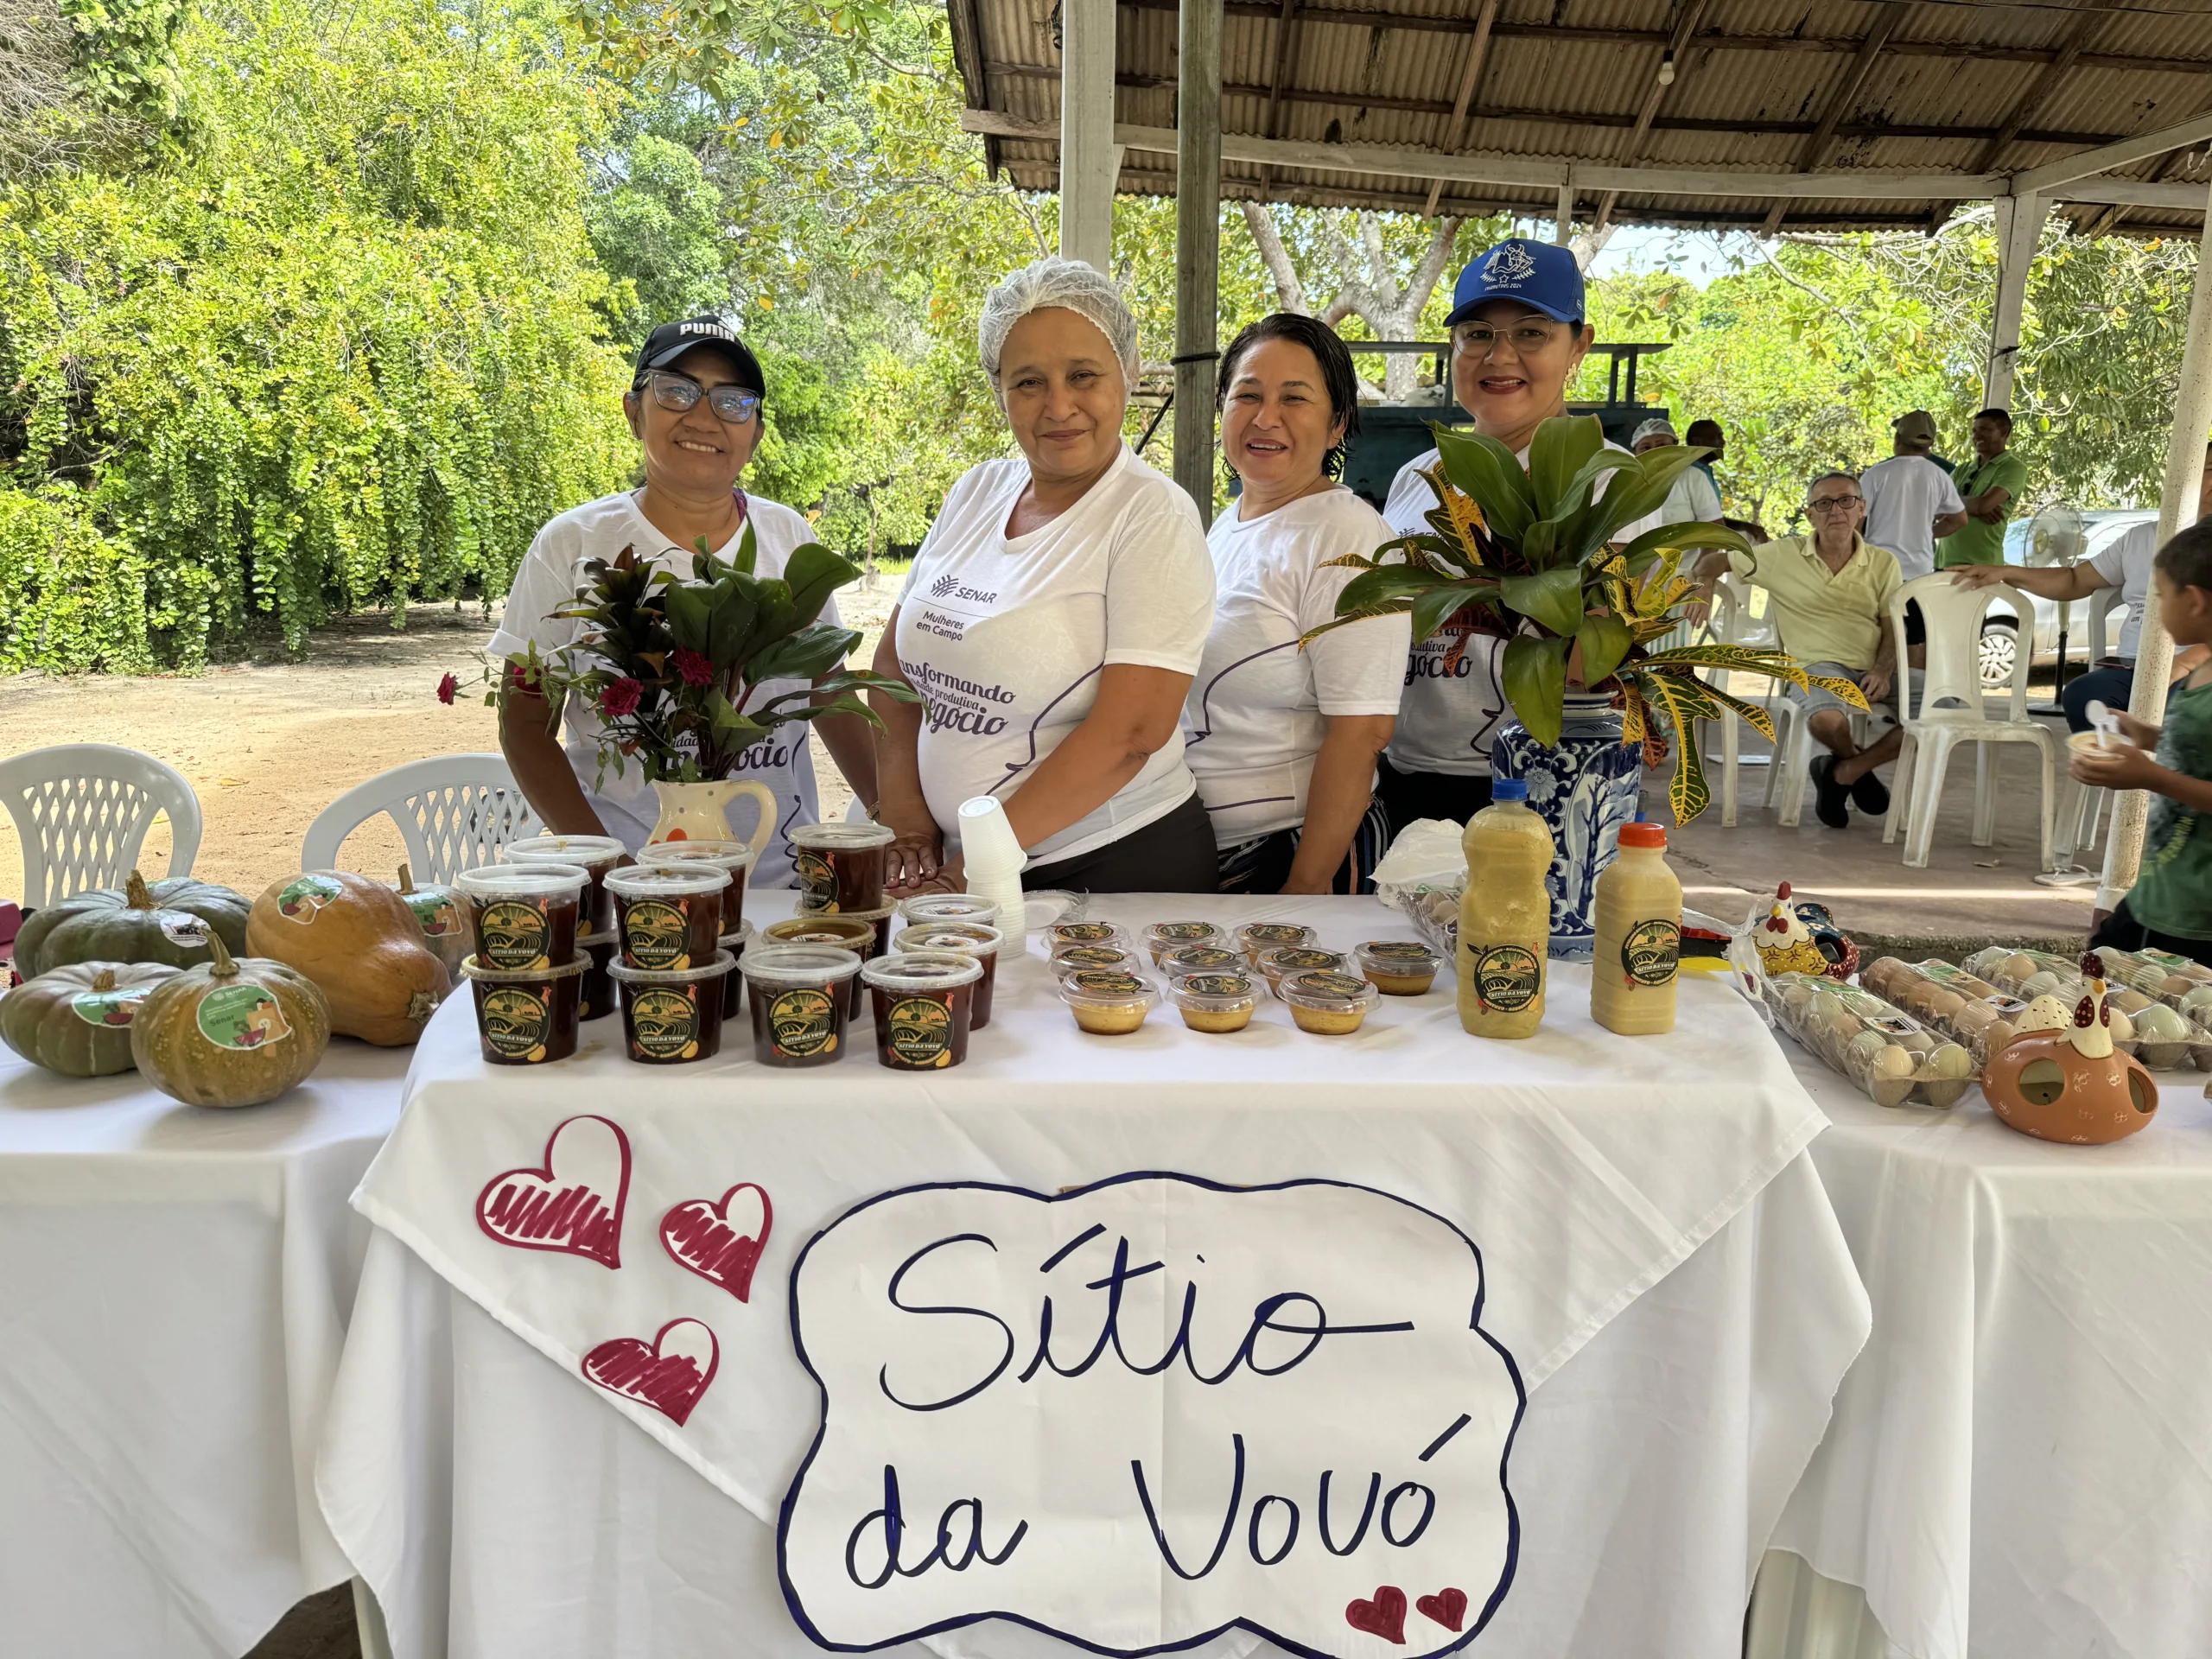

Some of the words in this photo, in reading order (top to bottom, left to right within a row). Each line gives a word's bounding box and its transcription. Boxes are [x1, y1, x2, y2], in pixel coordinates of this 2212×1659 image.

[679, 322, 735, 342] PUMA
[955, 587, 997, 603] SENAR
[923, 611, 964, 630] Mulheres
[916, 621, 931, 632] em
[933, 626, 963, 641] Campo
[899, 659, 1016, 704] ansformando
[935, 689, 979, 711] produtiva
[210, 1014, 235, 1027] Senar
[880, 1223, 1414, 1412] Sítio
[845, 1464, 1028, 1590] da
[1130, 1413, 1471, 1580] Vovó
